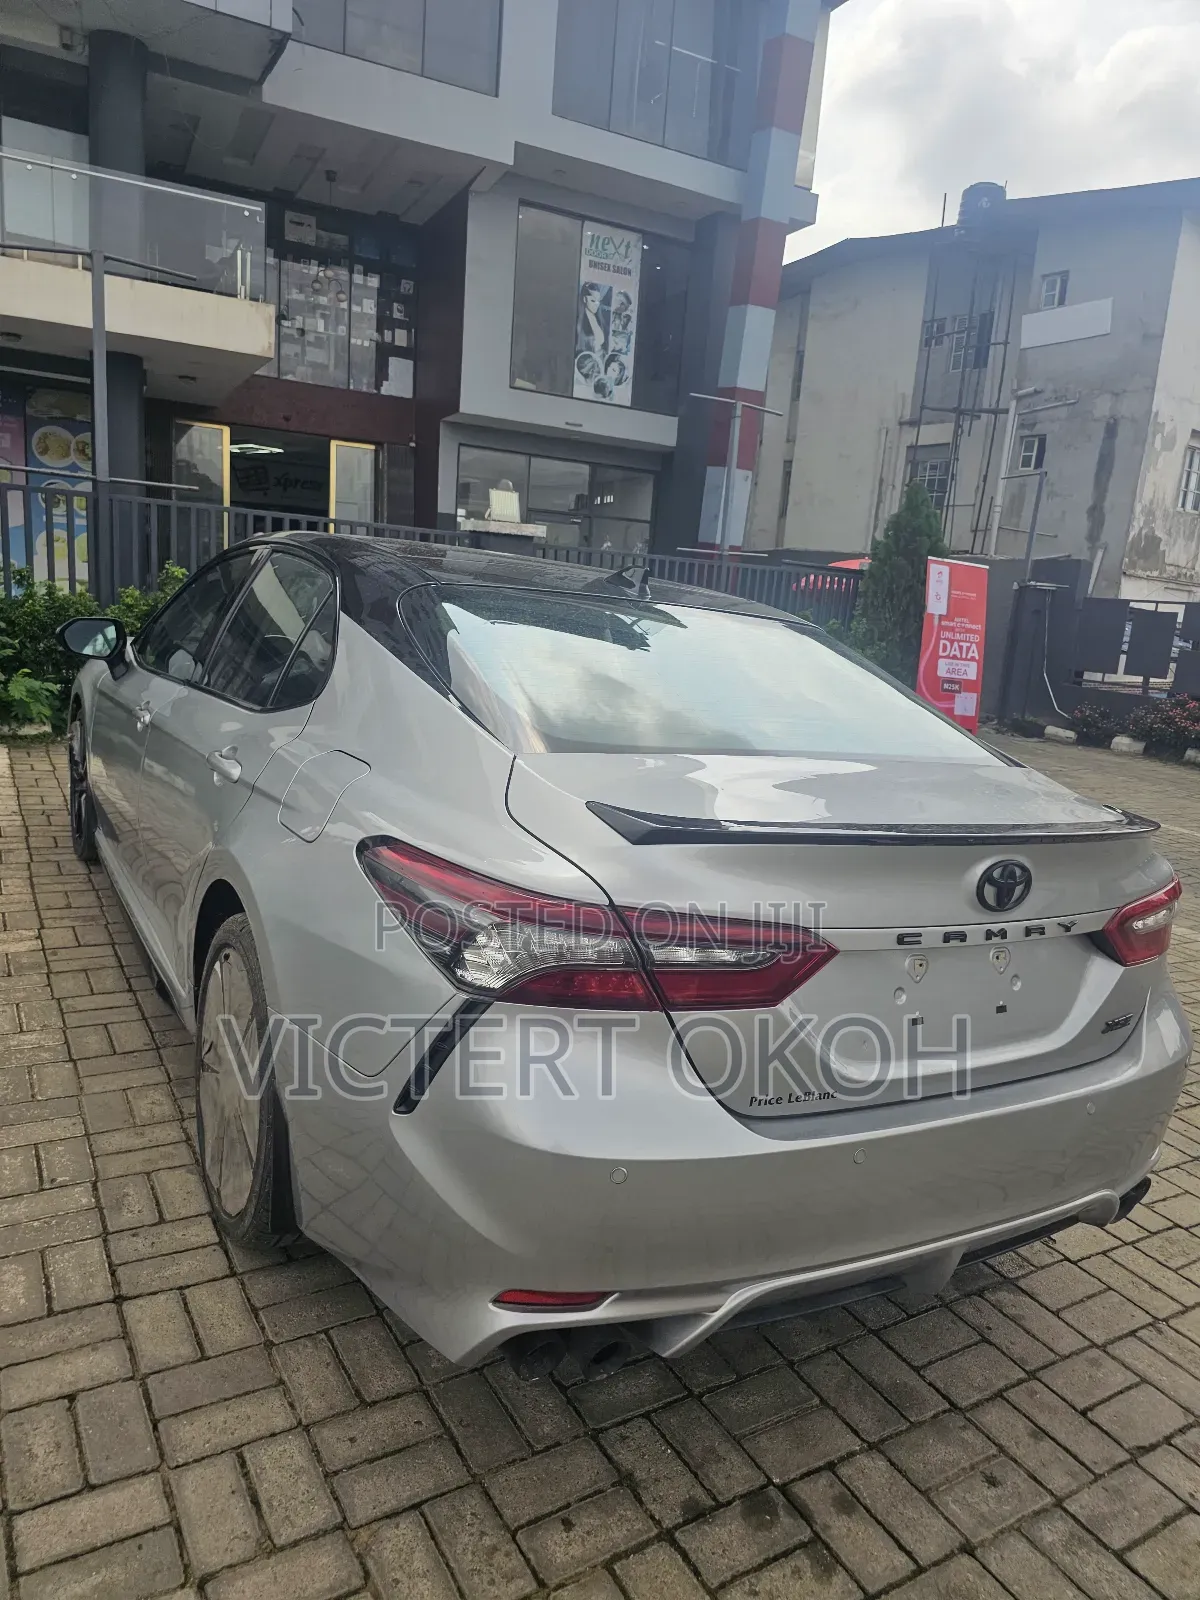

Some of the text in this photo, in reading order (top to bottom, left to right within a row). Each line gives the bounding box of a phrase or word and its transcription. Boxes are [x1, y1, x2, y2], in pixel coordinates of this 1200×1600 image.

[588, 260, 632, 277] UNISEX SALON
[940, 630, 980, 642] UNLIMITED
[939, 640, 979, 660] DATA
[945, 666, 968, 678] AREA
[896, 919, 1079, 946] CAMRY
[748, 1090, 838, 1108] Price LeBlanc
